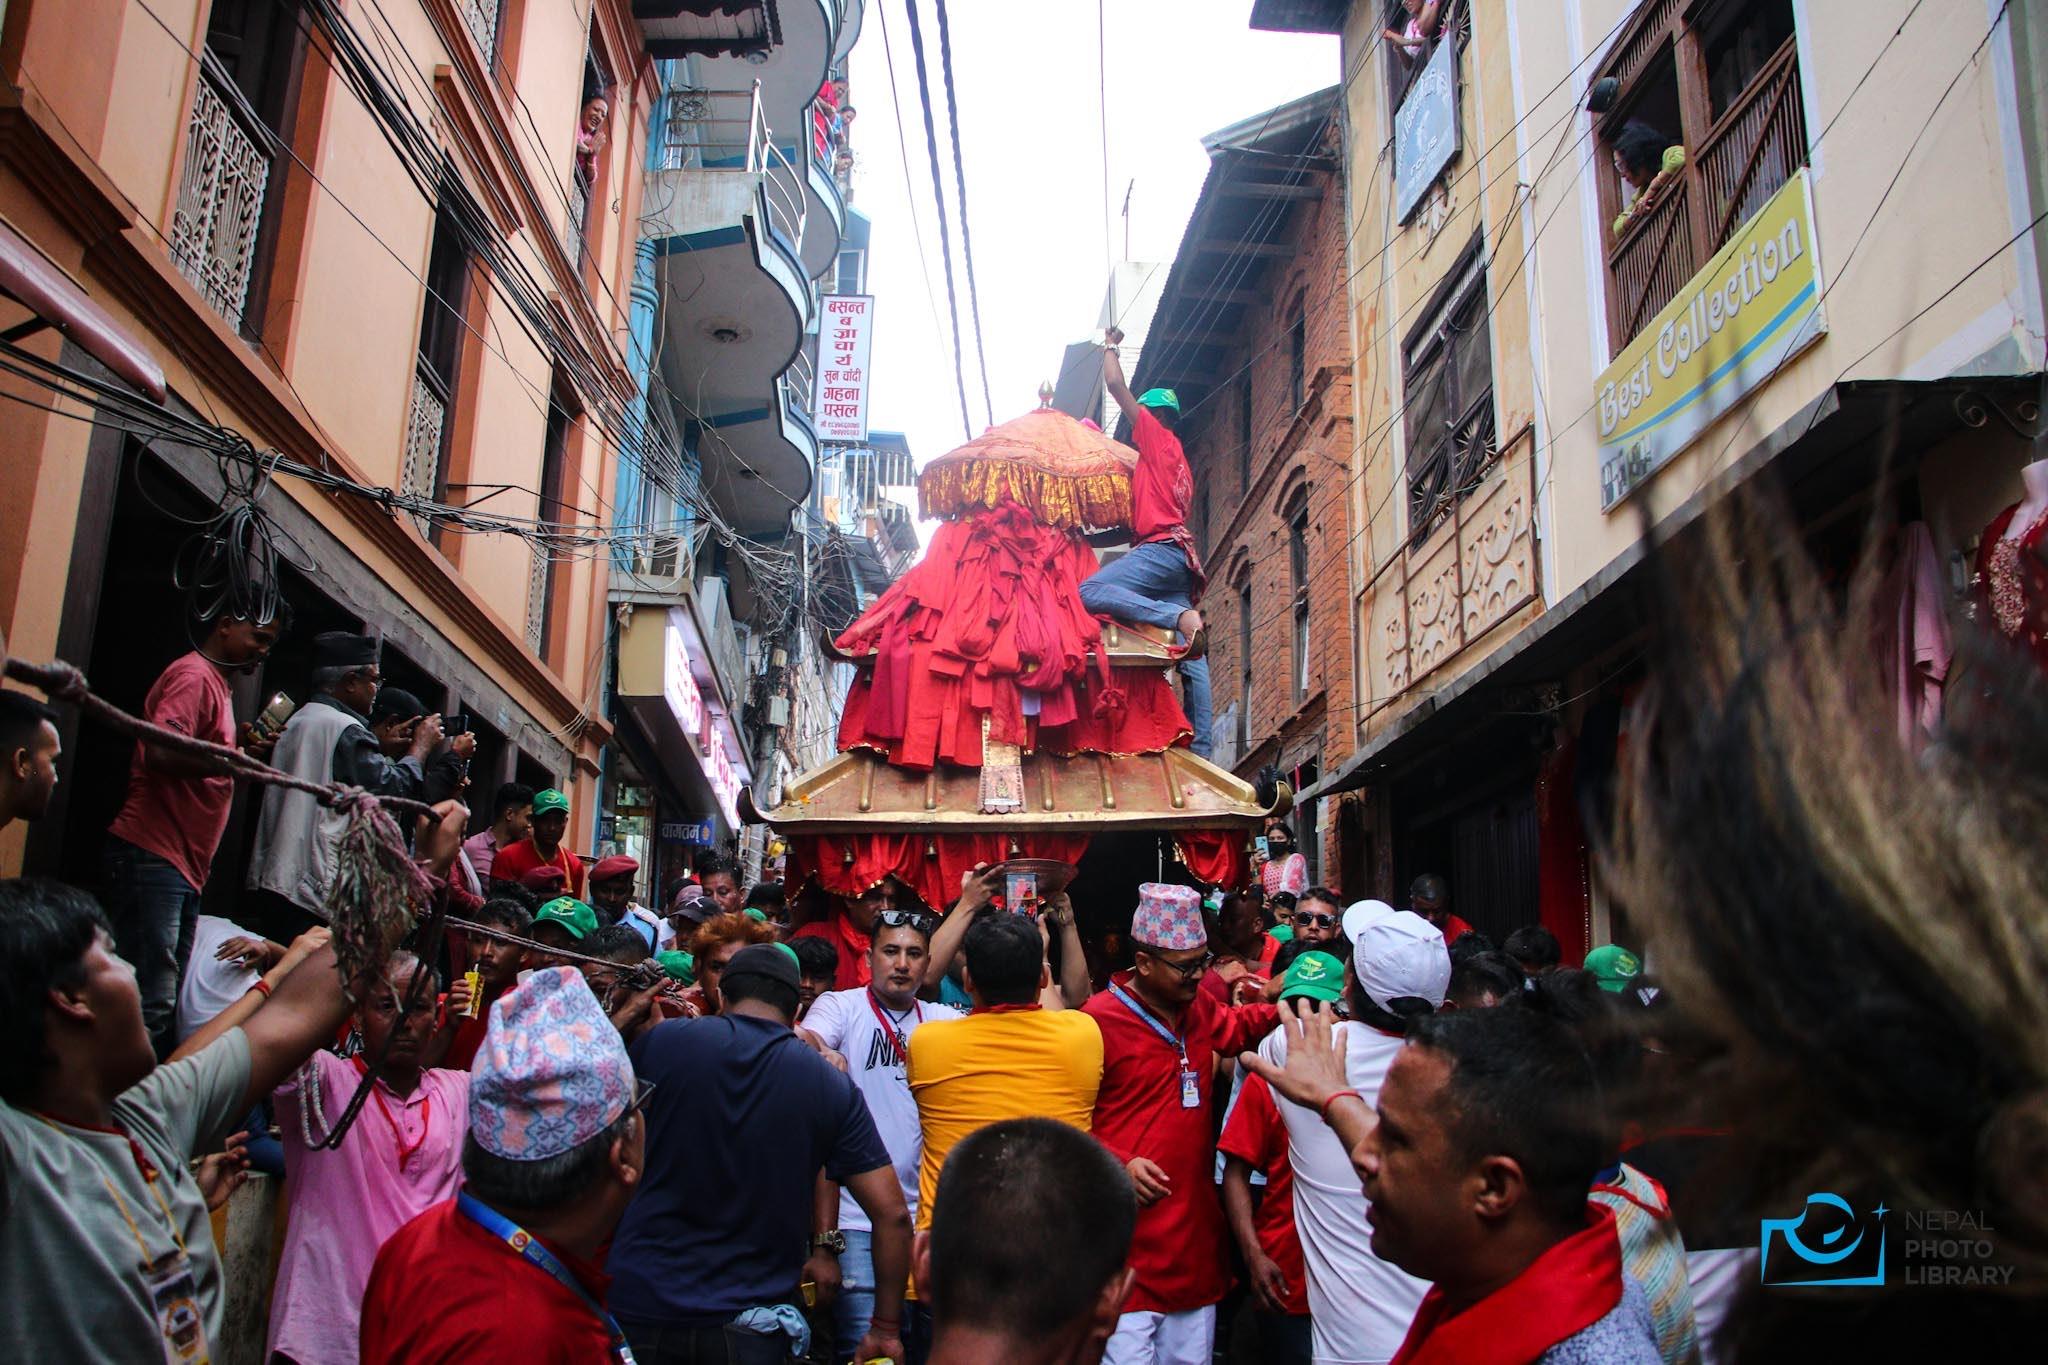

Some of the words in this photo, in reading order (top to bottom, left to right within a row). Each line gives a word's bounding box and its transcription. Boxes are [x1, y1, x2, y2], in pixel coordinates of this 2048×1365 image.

[828, 300, 866, 315] बसन्त
[1599, 352, 1654, 437] Best
[1656, 216, 1804, 379] Collection
[824, 370, 839, 382] सुन
[823, 387, 860, 401] गहना
[824, 404, 859, 418] पसल
